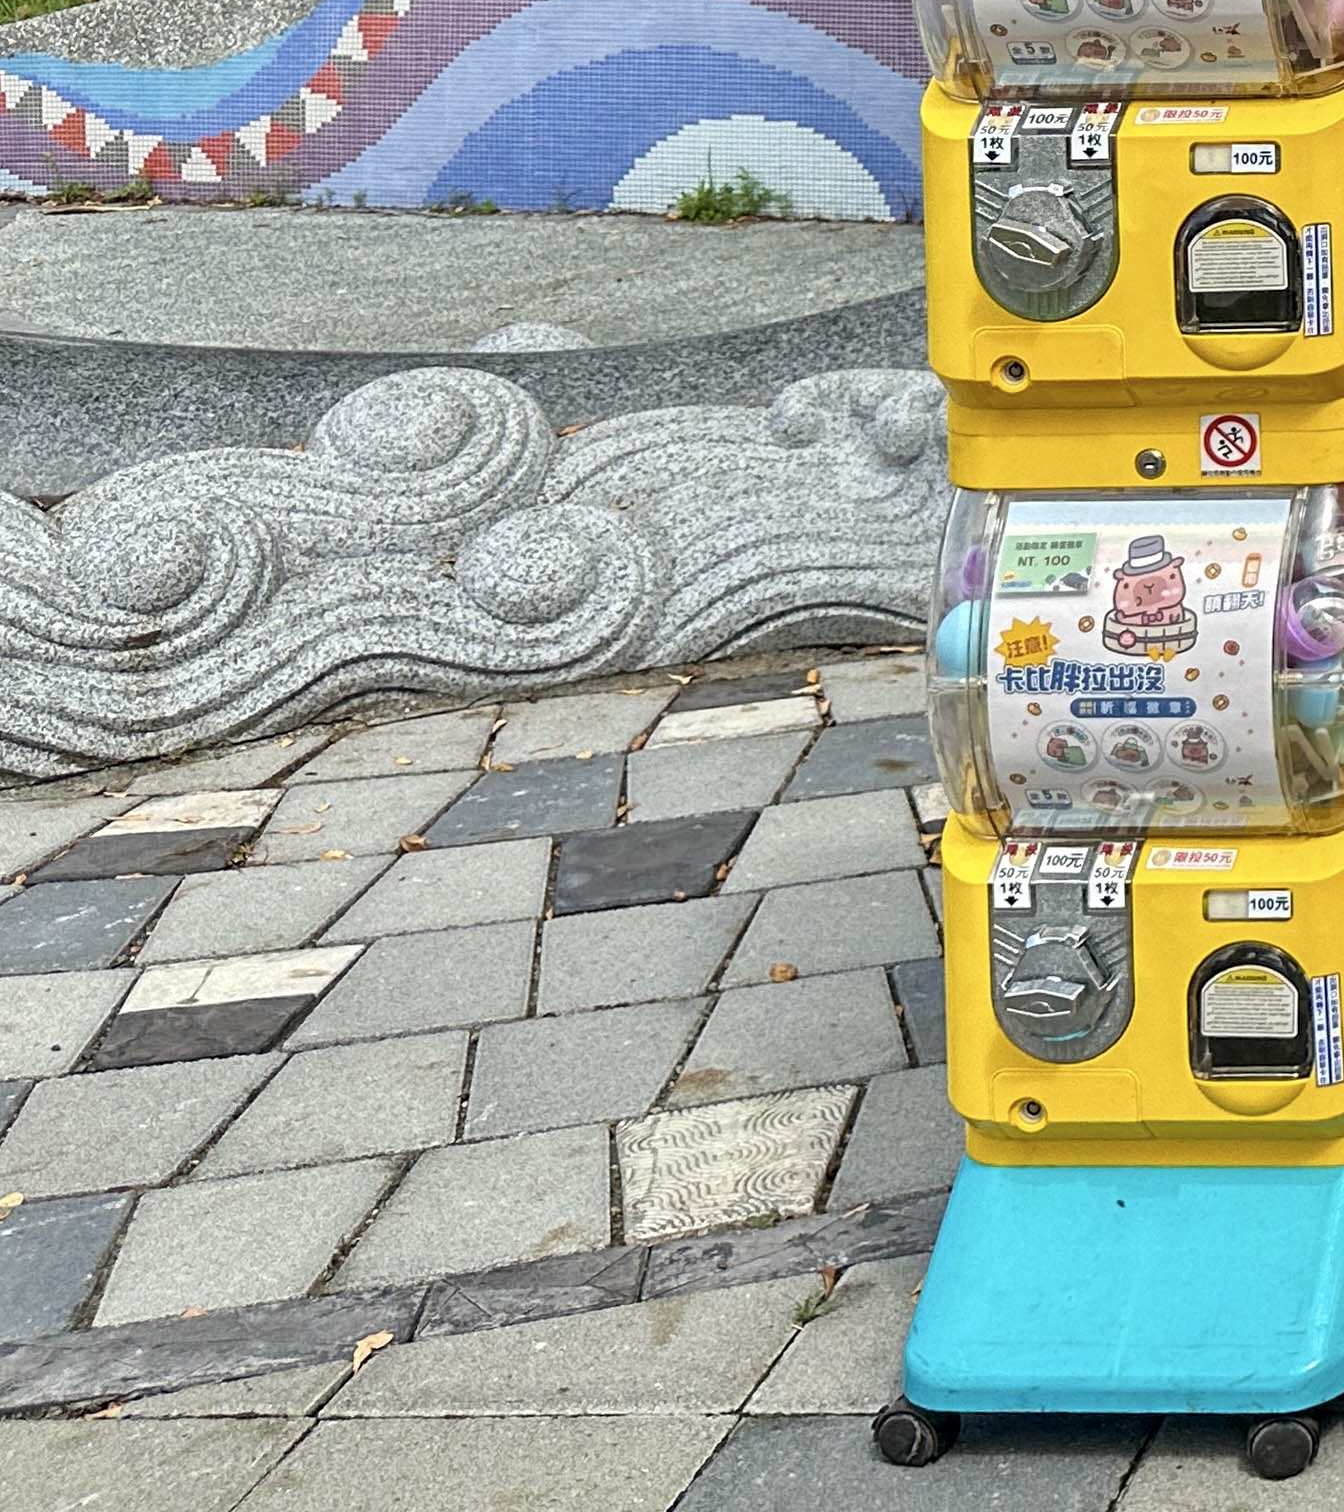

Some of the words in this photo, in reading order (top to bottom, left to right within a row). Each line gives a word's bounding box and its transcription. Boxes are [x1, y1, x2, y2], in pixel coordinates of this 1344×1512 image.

[1028, 112, 1068, 125] 100元
[979, 123, 1012, 135] 50元
[1077, 121, 1109, 134] 50元
[980, 137, 1004, 150] 1枚
[1079, 134, 1102, 148] 1枚
[1233, 150, 1274, 166] 100元
[1044, 554, 1070, 567] 100
[1006, 634, 1048, 658] 注意!
[996, 659, 1165, 694] 卡比胖拉出沒
[1045, 853, 1082, 868] 100元
[1174, 850, 1233, 865] 限投50元
[999, 867, 1029, 879] 50元
[1095, 867, 1125, 879] 50元
[1000, 882, 1024, 895] 1枚
[1096, 882, 1119, 895] 1枚
[1250, 896, 1290, 912] 100元
